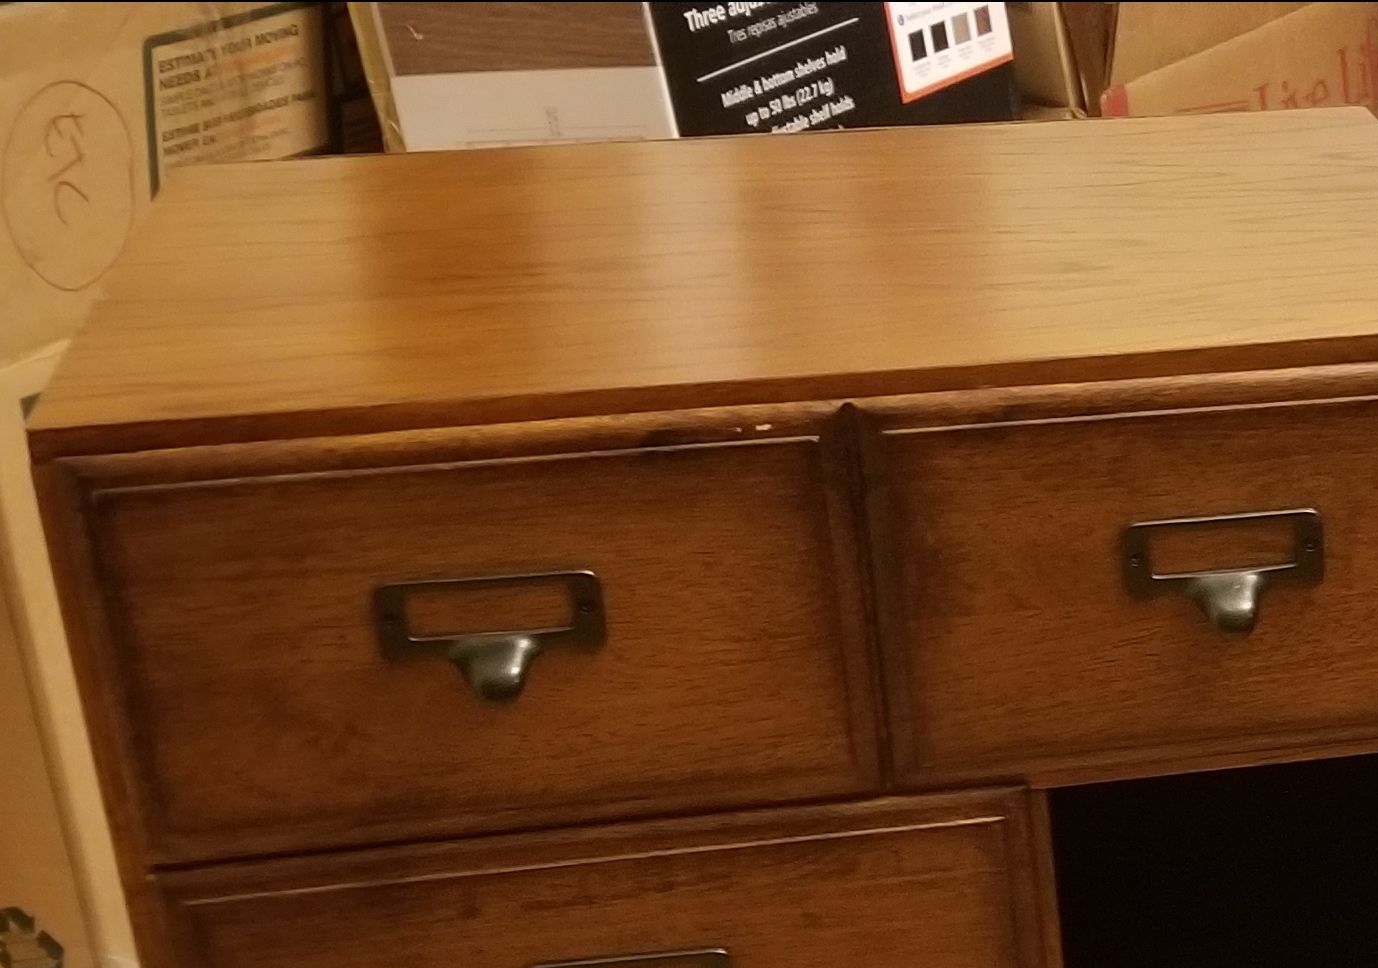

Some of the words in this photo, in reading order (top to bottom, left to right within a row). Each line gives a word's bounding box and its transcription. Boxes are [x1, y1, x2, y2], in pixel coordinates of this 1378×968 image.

[683, 4, 726, 32] Three
[729, 29, 747, 43] Tres
[748, 17, 778, 38] repisas
[777, 2, 819, 28] ajustables
[159, 49, 217, 73] ESTIMAT
[255, 24, 299, 46] MOVING
[721, 84, 754, 108] Middle
[761, 70, 794, 92] bottom
[794, 57, 827, 79] shelves
[825, 45, 847, 65] hold
[746, 112, 759, 127] up
[758, 106, 770, 120] to
